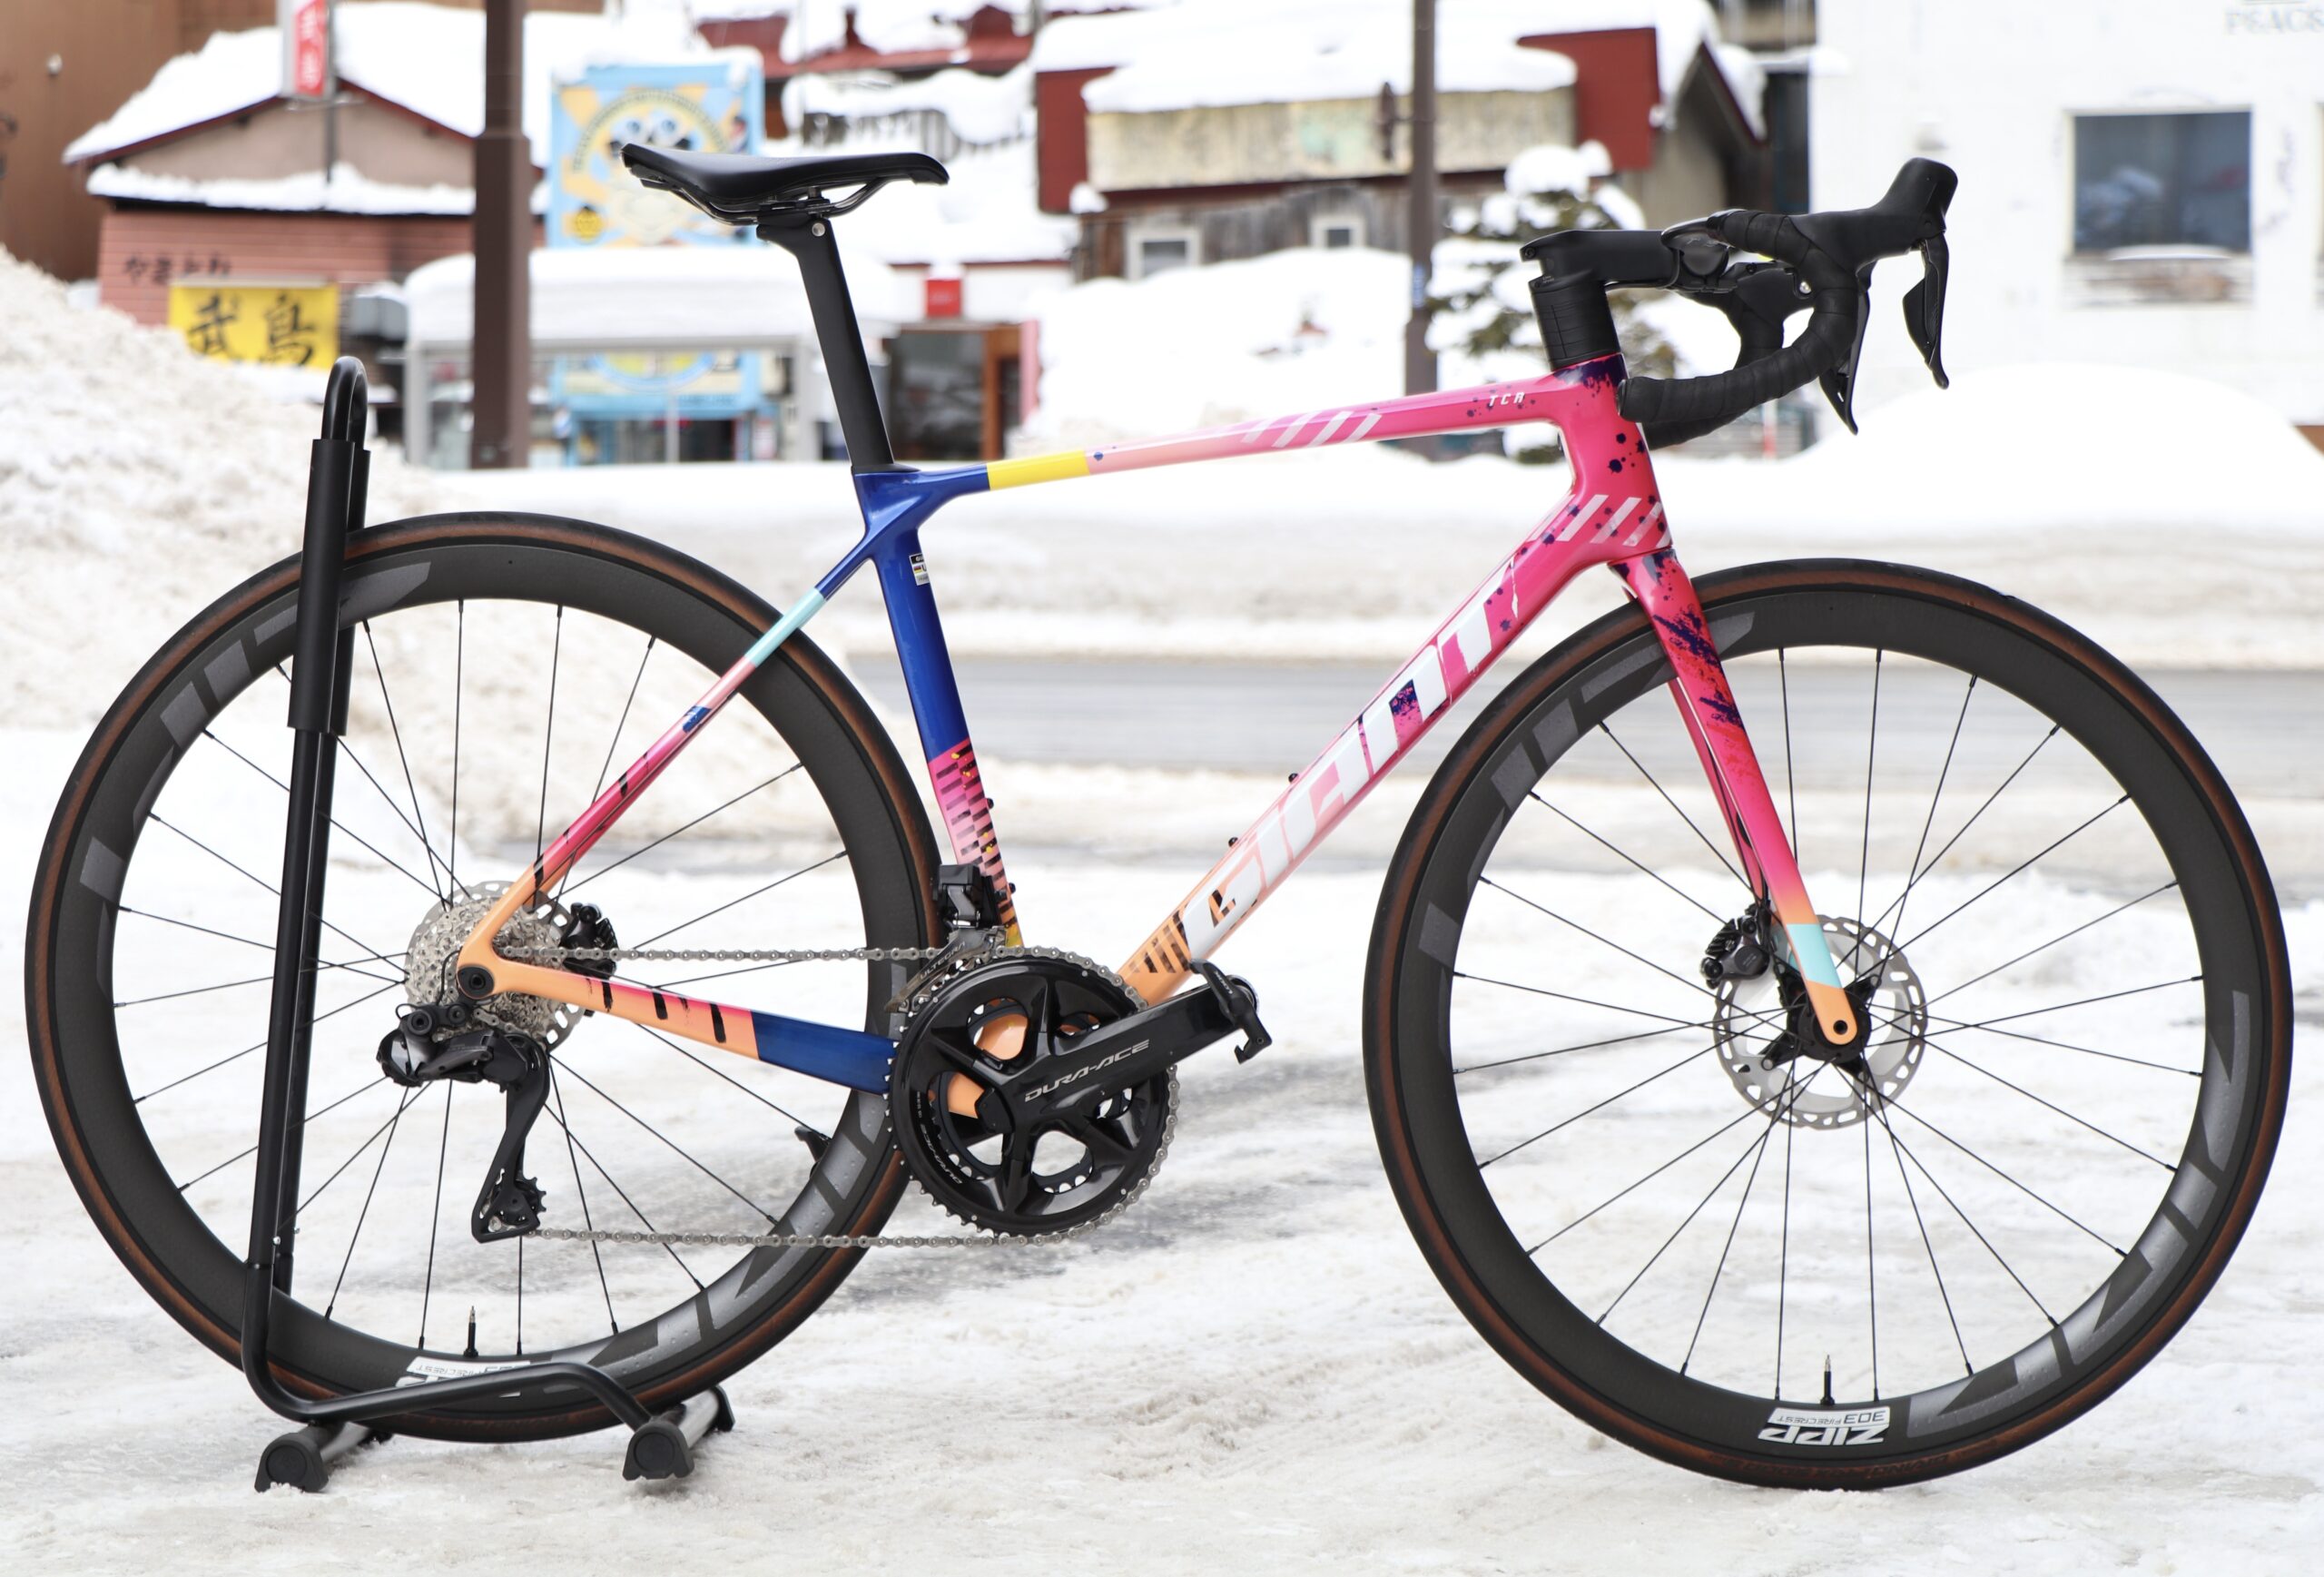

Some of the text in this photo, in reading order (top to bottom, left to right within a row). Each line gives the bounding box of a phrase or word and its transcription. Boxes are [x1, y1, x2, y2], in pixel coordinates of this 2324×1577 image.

[1489, 392, 1525, 407] TCR
[1024, 1039, 1150, 1102] DURA-ACE
[1777, 1410, 1886, 1425] 303 FIRECREST
[1758, 1424, 1890, 1446] ZIPP
